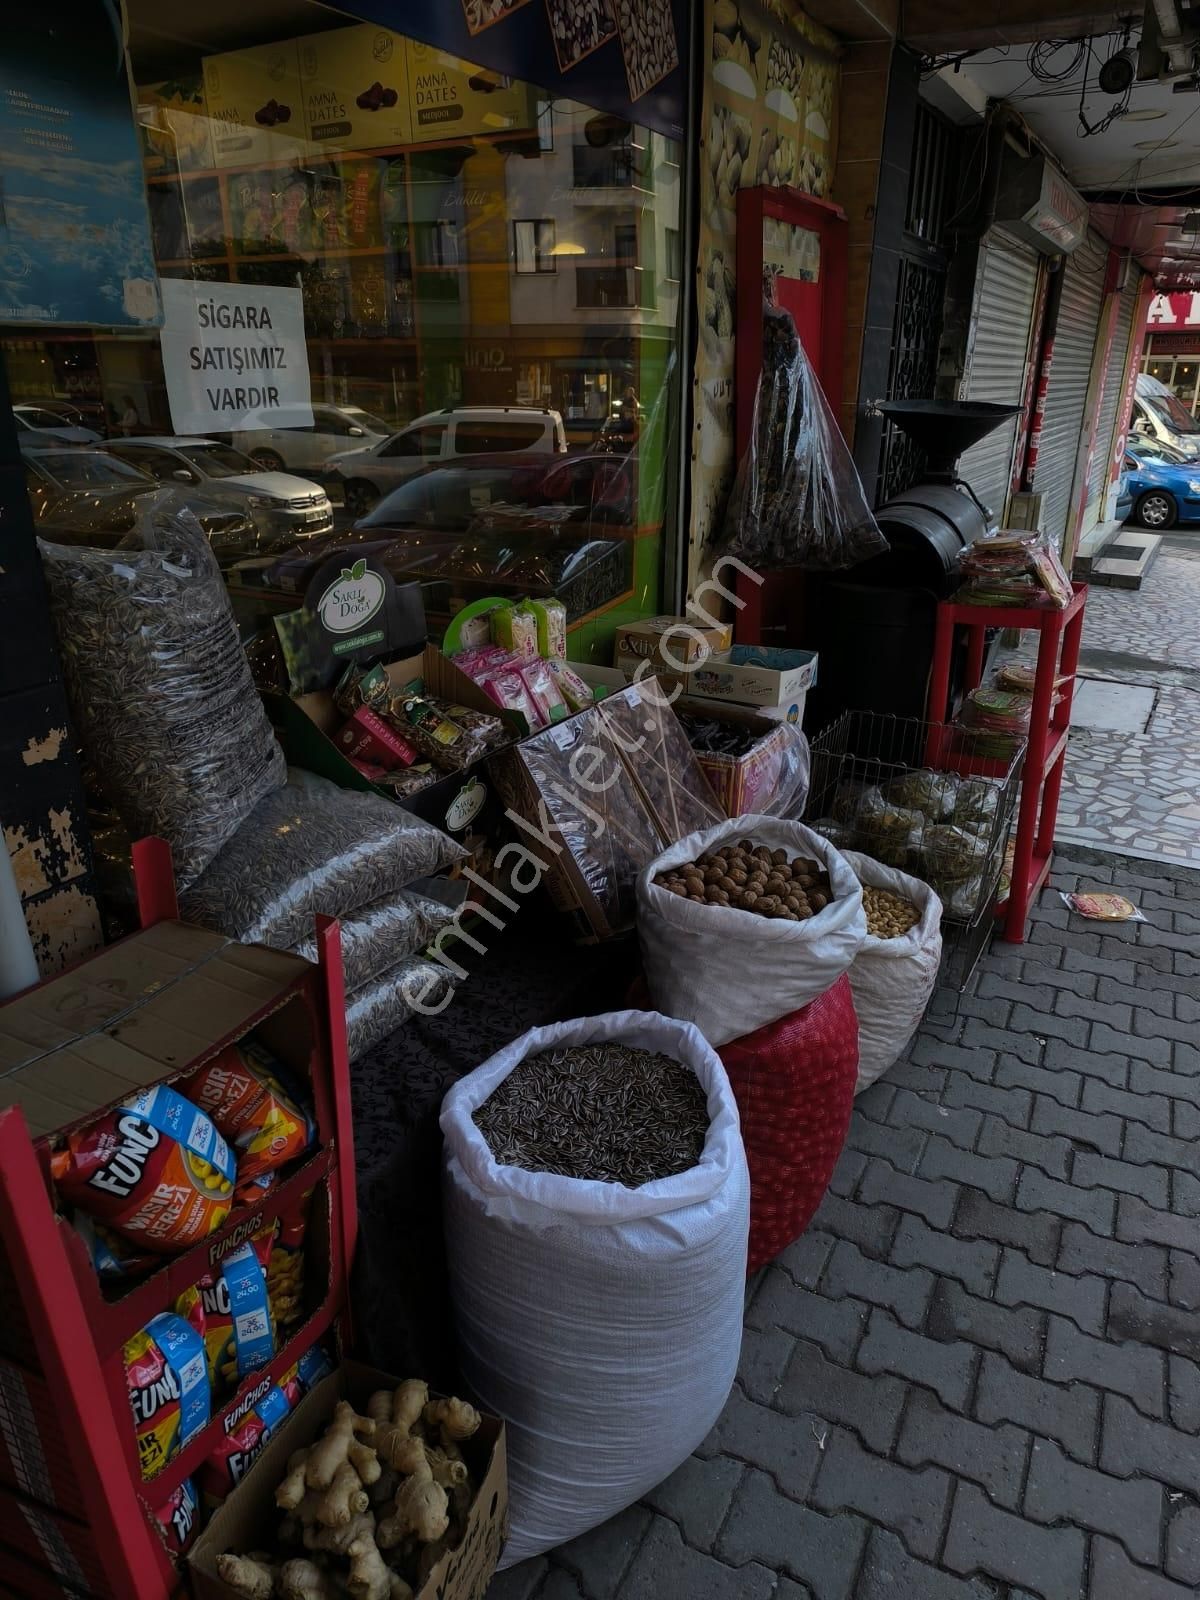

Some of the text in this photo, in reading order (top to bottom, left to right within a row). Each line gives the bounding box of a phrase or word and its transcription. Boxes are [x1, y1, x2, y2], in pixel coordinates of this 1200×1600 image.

[415, 72, 448, 89] AMNA
[308, 91, 338, 105] AMNA
[416, 86, 457, 105] DATES
[309, 104, 347, 122] DATES
[198, 298, 273, 330] SİGARA
[189, 346, 288, 376] SATIŞIMIZ
[206, 386, 281, 412] VARDIR
[89, 1115, 161, 1197] FUNC
[122, 1182, 177, 1230] MISIR
[224, 1375, 273, 1433] FUNCHOS
